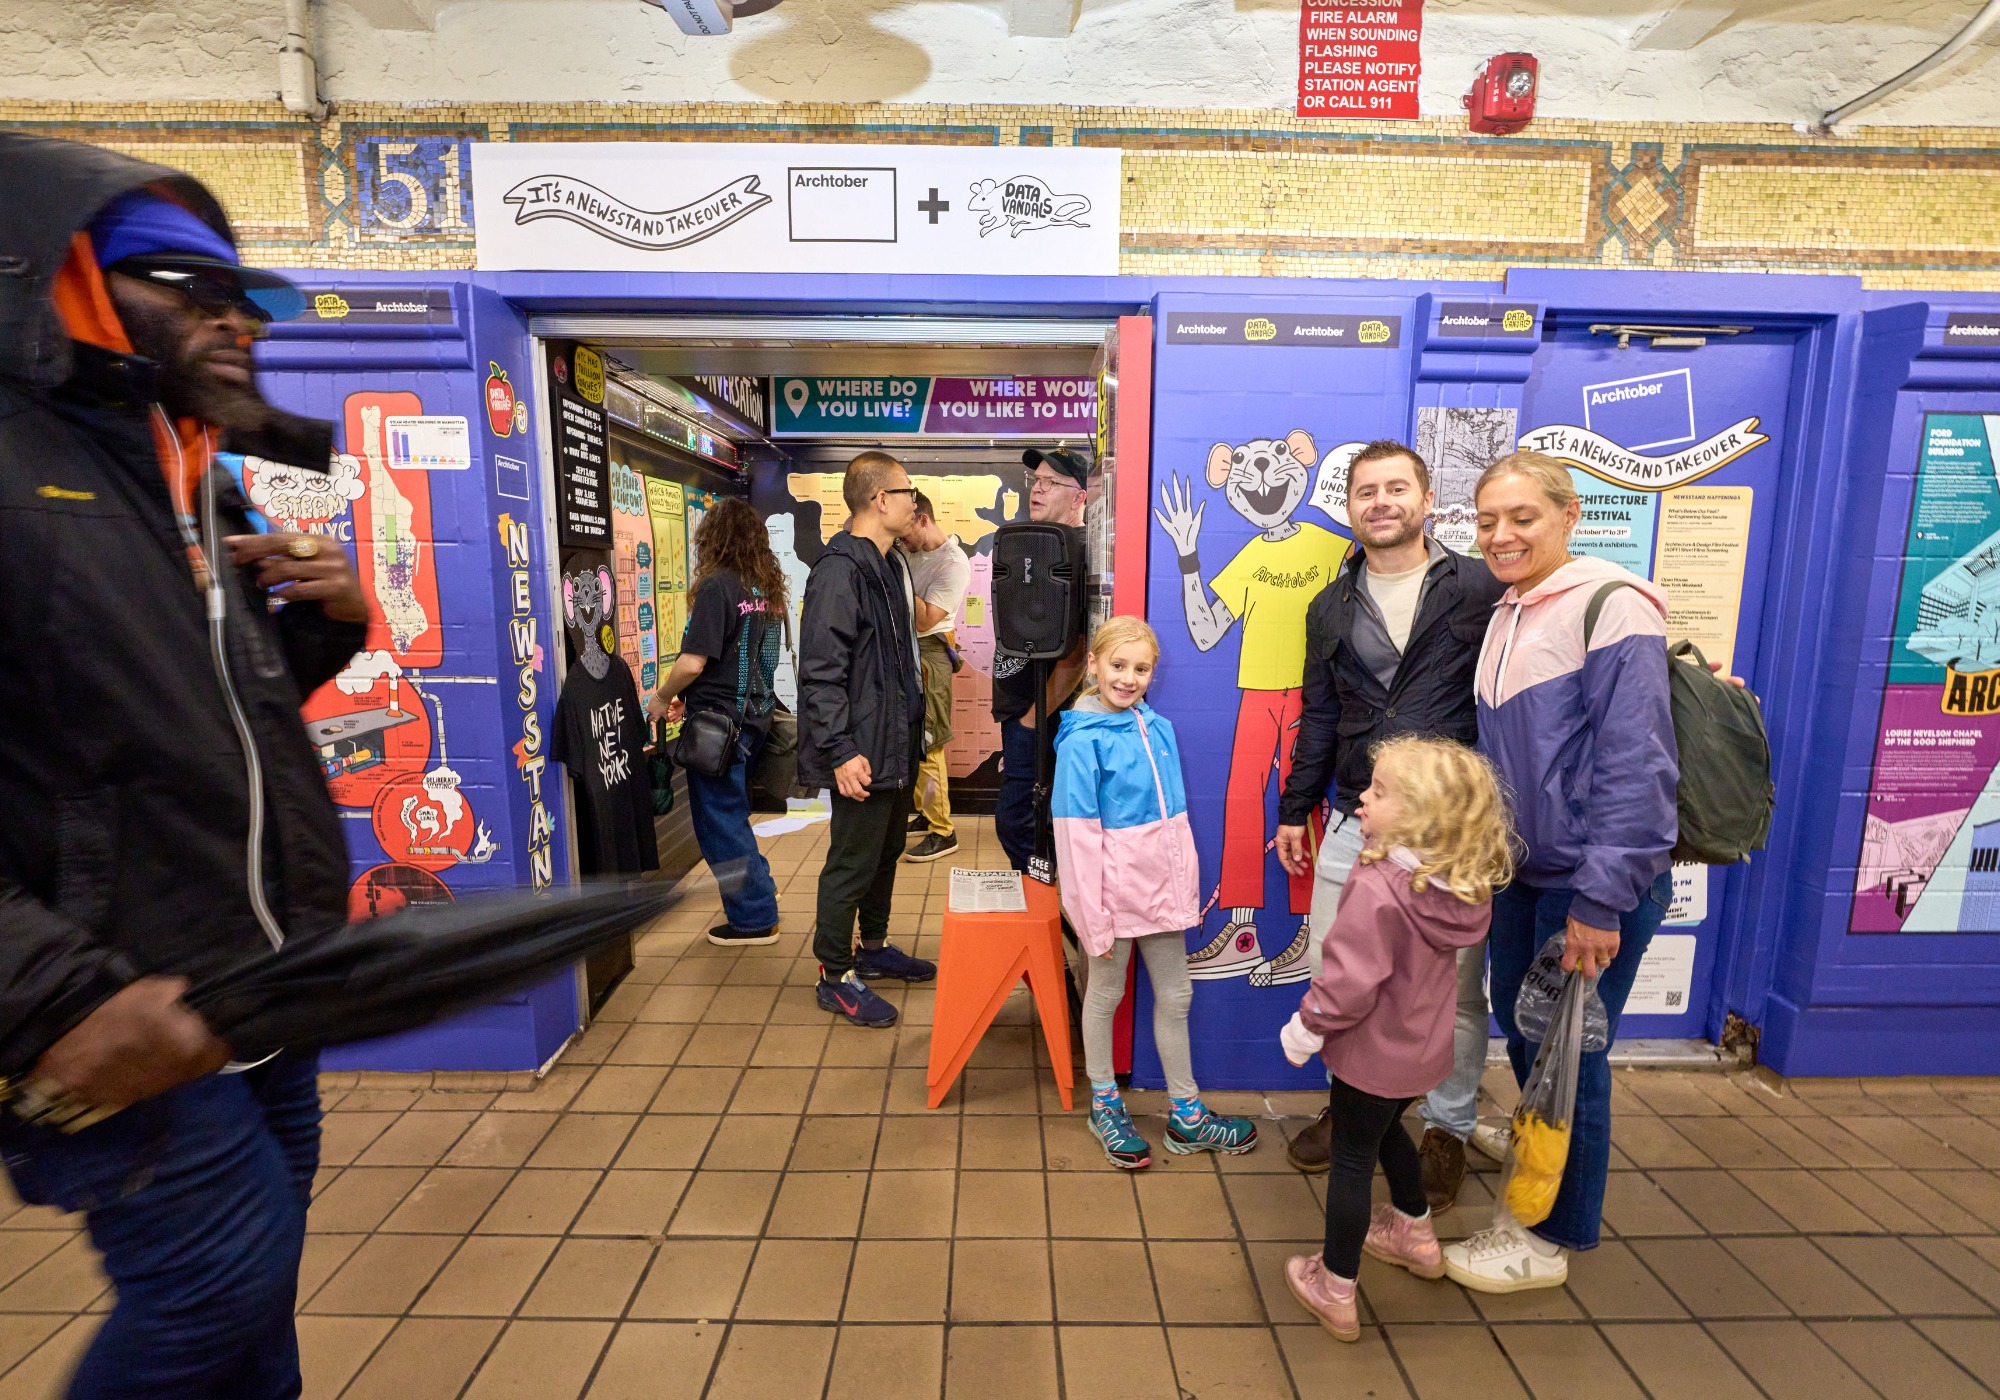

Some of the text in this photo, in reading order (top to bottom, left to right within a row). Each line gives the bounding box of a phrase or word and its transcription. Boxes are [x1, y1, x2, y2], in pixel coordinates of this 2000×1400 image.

[688, 10, 705, 25] NOT
[1311, 12, 1398, 24] FIRE ALARM
[1307, 28, 1418, 42] WHEN SOUNDING
[1305, 45, 1378, 58] FLASHING
[1304, 62, 1417, 76] PLEASE NOTIFY
[1304, 79, 1417, 93] STATION AGENT
[1304, 96, 1393, 109] OR CALL 911
[373, 143, 468, 229] 51
[794, 174, 869, 189] Archtober
[1005, 182, 1041, 200] DATA
[1001, 195, 1053, 219] VANDALS
[565, 194, 576, 206] A
[577, 193, 665, 237] NEWSSTAND
[665, 193, 743, 236] TAKEOVER
[317, 296, 428, 313] DATA Archtober
[1441, 311, 1525, 326] Archtober DATA
[1504, 318, 1533, 331] VANDALS
[1177, 319, 1382, 337] Archtober DATA Archtober DATA
[1245, 325, 1390, 342] VANDALS VANDALS
[587, 355, 598, 368] HAS
[489, 387, 505, 399] DATA
[817, 380, 917, 397] WHERE DO
[969, 380, 1037, 398] WHERE
[1591, 382, 1663, 406] Archtober
[817, 399, 912, 418] YOU LIVE?
[938, 401, 979, 418] YOU
[987, 401, 1025, 418] LIKE
[1033, 401, 1058, 418] TO
[1930, 428, 1953, 438] FORD
[1928, 438, 1982, 448] FOUNDATION
[1570, 438, 1579, 450] A
[1579, 440, 1664, 479] NEWSSTAND
[1664, 433, 1742, 477] TAKEOVER
[1927, 447, 1965, 457] BUILDING
[497, 458, 520, 472] Archtober
[1320, 479, 1348, 494] UNDE
[270, 492, 347, 520] STEAM
[1580, 510, 1632, 521] FESTIVAL
[308, 520, 352, 542] NYC
[1575, 528, 1602, 536] October
[1577, 541, 1599, 549] events
[1252, 564, 1321, 589] Archtober
[506, 521, 553, 896] NEWSSTAN
[1885, 729, 1983, 739] LOUISE NEVELSON CHAPEL
[1884, 737, 1977, 747] OF THE GOOD SHEPHERD
[425, 776, 459, 784] DELIBERATE
[427, 782, 453, 790] VENTING
[1030, 856, 1049, 872] FREE
[953, 869, 1020, 877] NEWSPAPER
[1027, 865, 1051, 882] TAKE ONE
[1680, 879, 1692, 887] PM
[1680, 896, 1692, 904] PM
